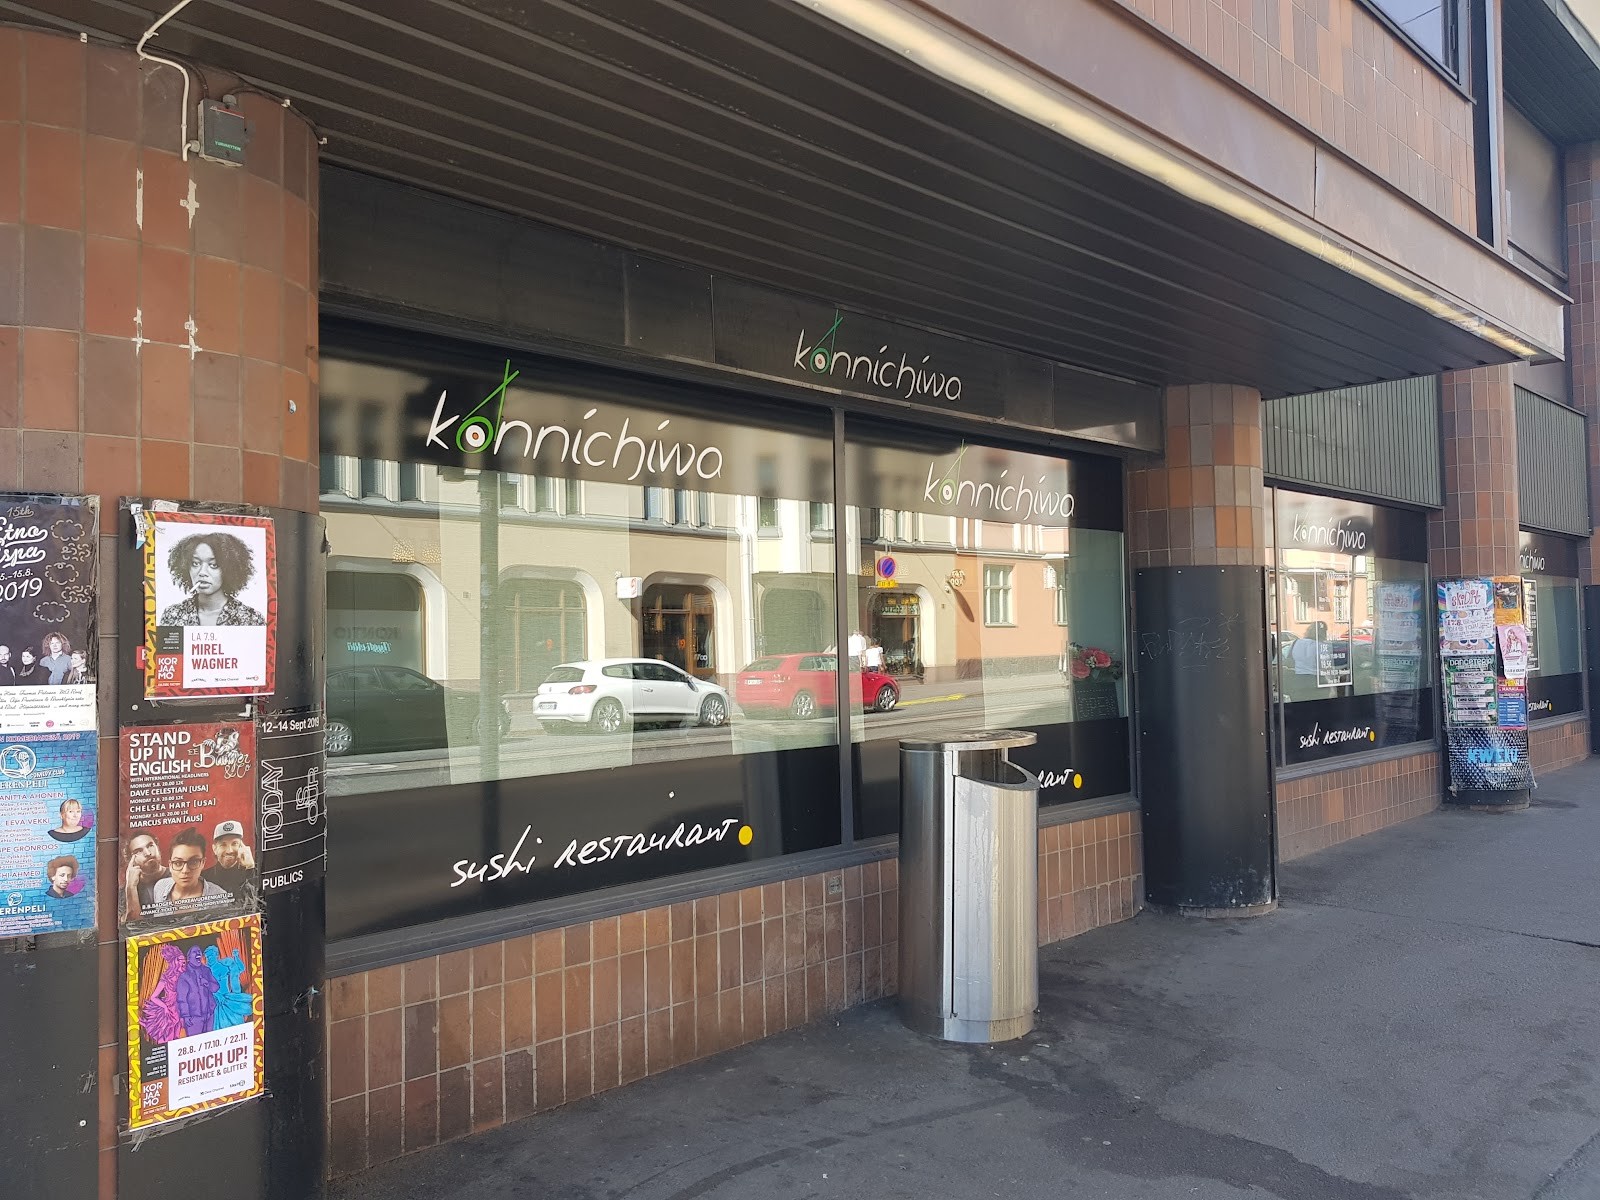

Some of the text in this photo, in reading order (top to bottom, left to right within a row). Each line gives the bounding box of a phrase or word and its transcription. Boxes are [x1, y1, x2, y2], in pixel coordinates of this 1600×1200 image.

[794, 325, 961, 400] konnichiwa
[426, 386, 724, 481] konnichiwa
[924, 456, 1076, 521] konnichiwa
[1293, 513, 1366, 552] konnichiwa
[191, 632, 217, 641] LA 7.9.
[191, 643, 225, 656] MIREL
[158, 657, 178, 665] KOR
[158, 664, 176, 672] JAA
[191, 657, 239, 670] WAGNER
[157, 672, 174, 680] MO
[289, 718, 306, 732] Sept
[307, 717, 319, 728] 2019
[130, 731, 191, 747] STAND
[1300, 722, 1321, 748] sushi
[130, 748, 153, 761] UP
[159, 746, 175, 760] IN
[129, 759, 191, 777] ENGLISH
[130, 789, 150, 797] DAVE
[151, 786, 188, 796] CELESTIAN
[130, 803, 166, 813] CHELSEA
[169, 801, 191, 810] HART
[261, 760, 283, 851] TODAY
[129, 819, 161, 828] MARCUS
[163, 816, 182, 826] RYAN
[450, 825, 543, 887] sushi
[262, 869, 303, 891] PUBLICS
[177, 1045, 197, 1057] 28.8.
[204, 1040, 222, 1050] 17.10.
[229, 1032, 248, 1044] 22.11.
[178, 1053, 223, 1077] PUNCH
[227, 1046, 248, 1064] UP!
[177, 1071, 215, 1086] RESISTANCE
[223, 1062, 248, 1075] GLITTER
[143, 1081, 163, 1093] KOR
[143, 1090, 161, 1100] JAA
[143, 1097, 159, 1108] MO
